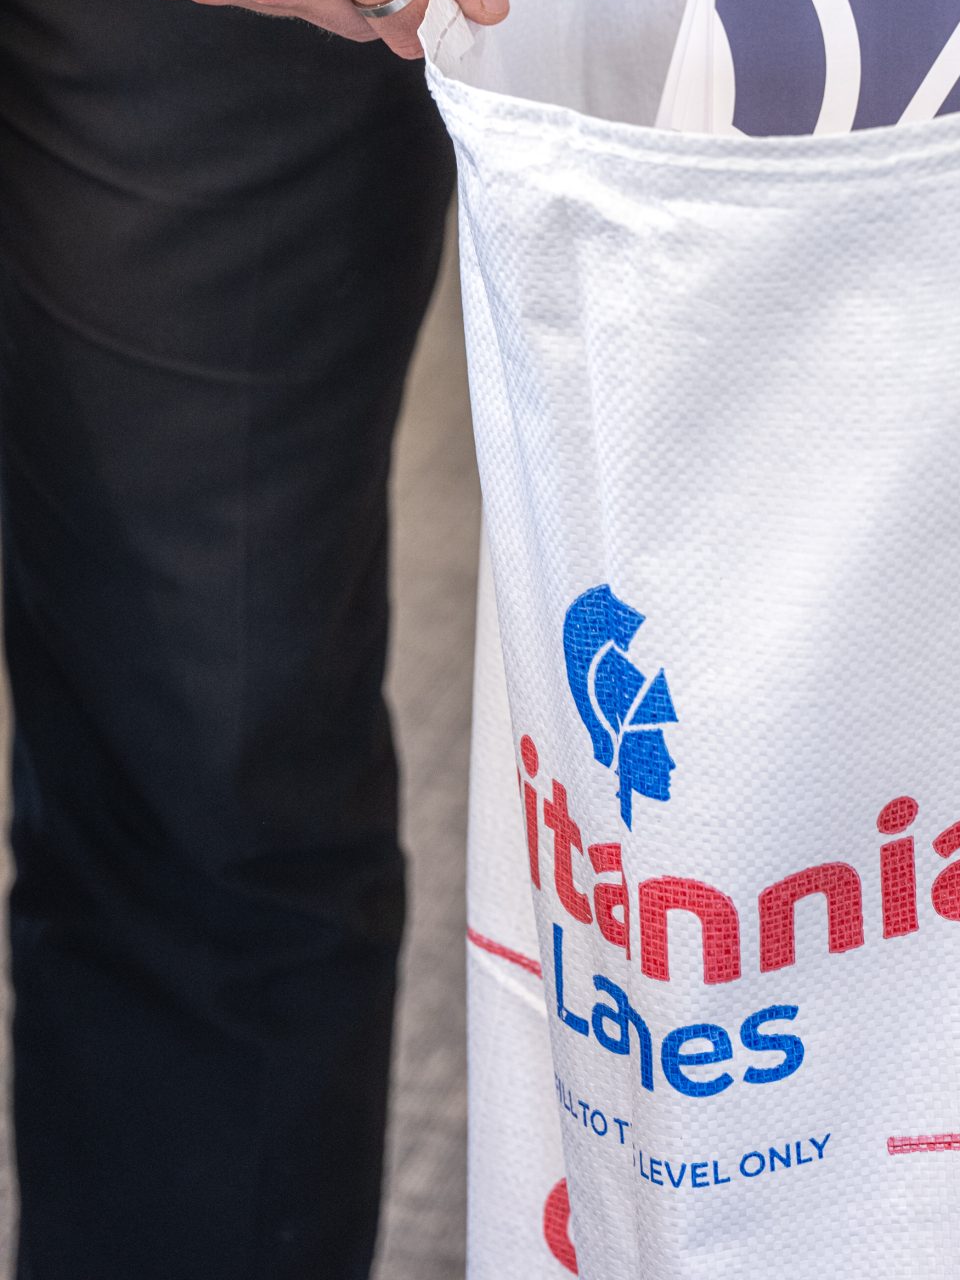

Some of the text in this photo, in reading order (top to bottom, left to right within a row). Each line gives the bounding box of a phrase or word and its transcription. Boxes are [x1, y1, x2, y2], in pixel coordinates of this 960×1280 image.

[578, 1099, 608, 1137] TO
[639, 1150, 731, 1189] LEVEL
[739, 1132, 831, 1178] ONLY
